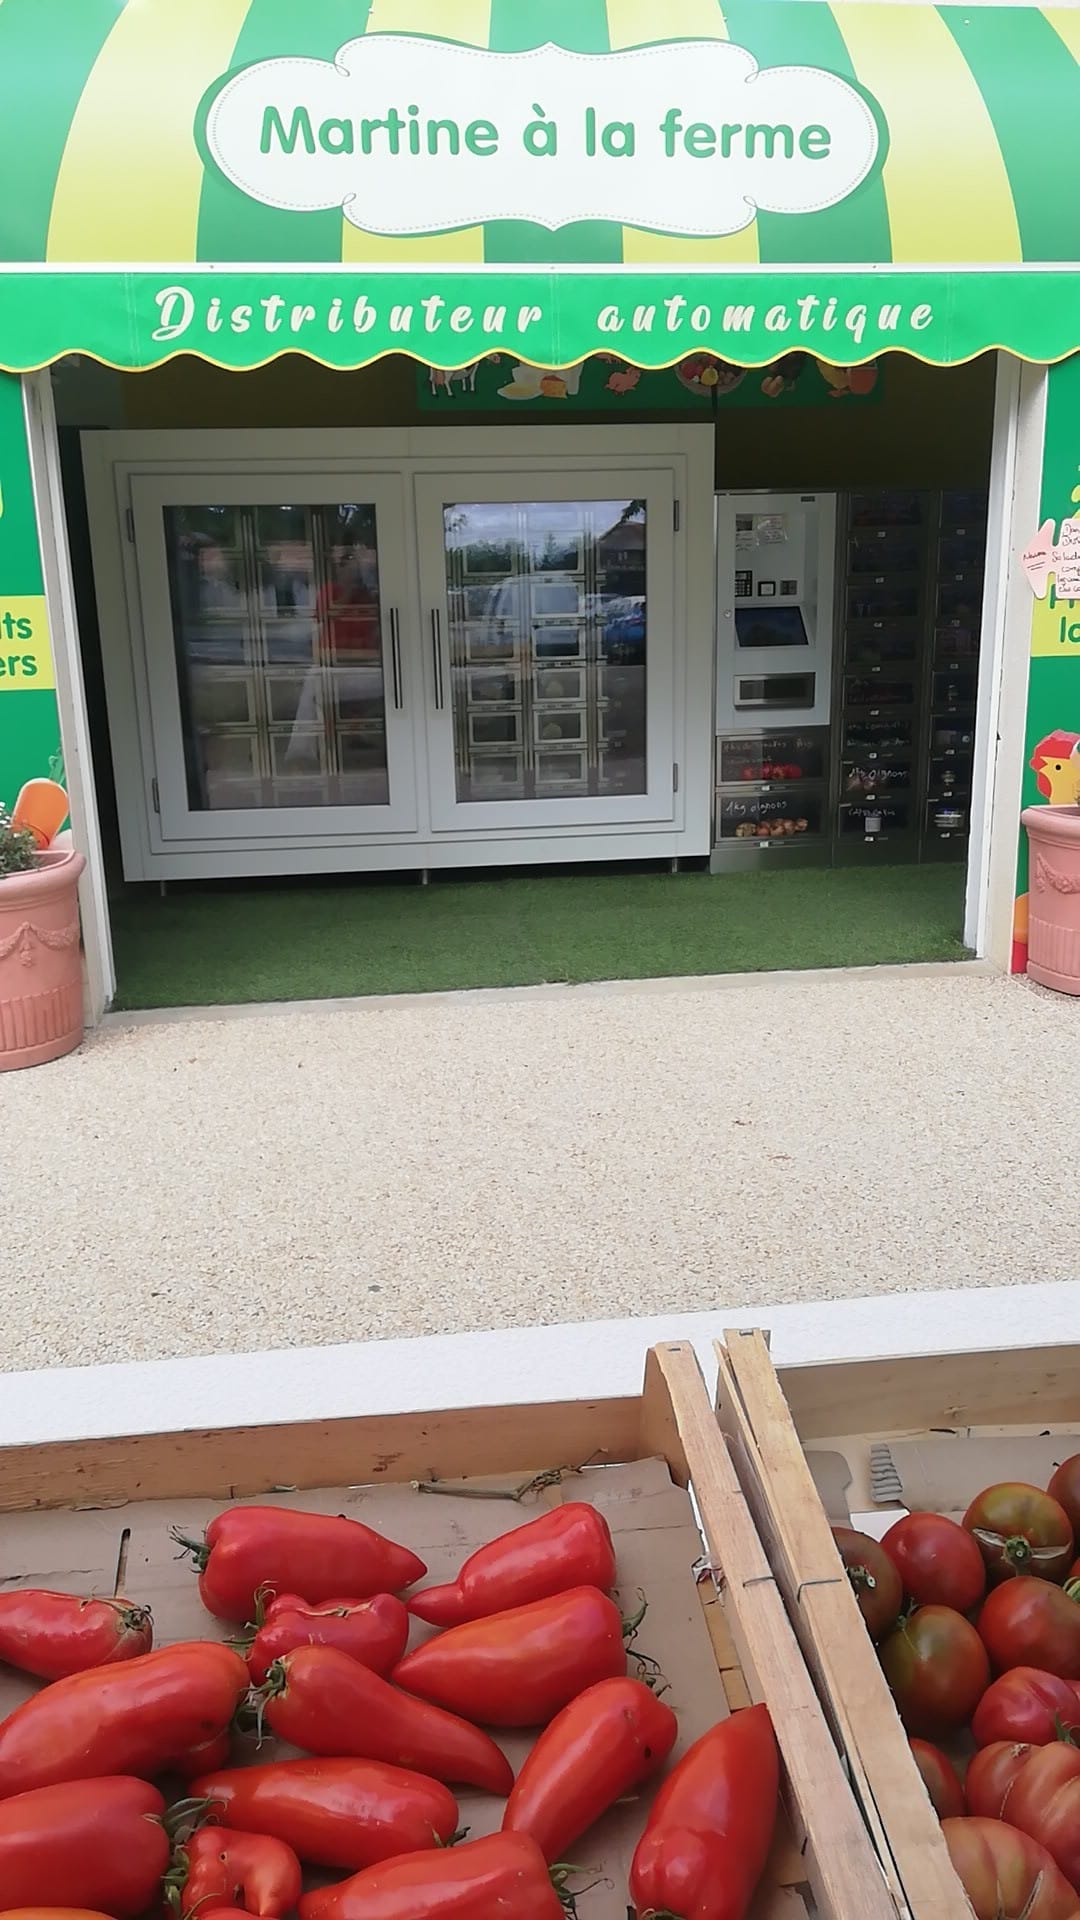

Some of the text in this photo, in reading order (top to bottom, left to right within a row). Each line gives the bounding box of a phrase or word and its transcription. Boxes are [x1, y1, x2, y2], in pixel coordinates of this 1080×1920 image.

[260, 104, 831, 160] Martine à la ferme
[153, 286, 934, 343] Distributeur automatique
[0, 612, 32, 639] ts
